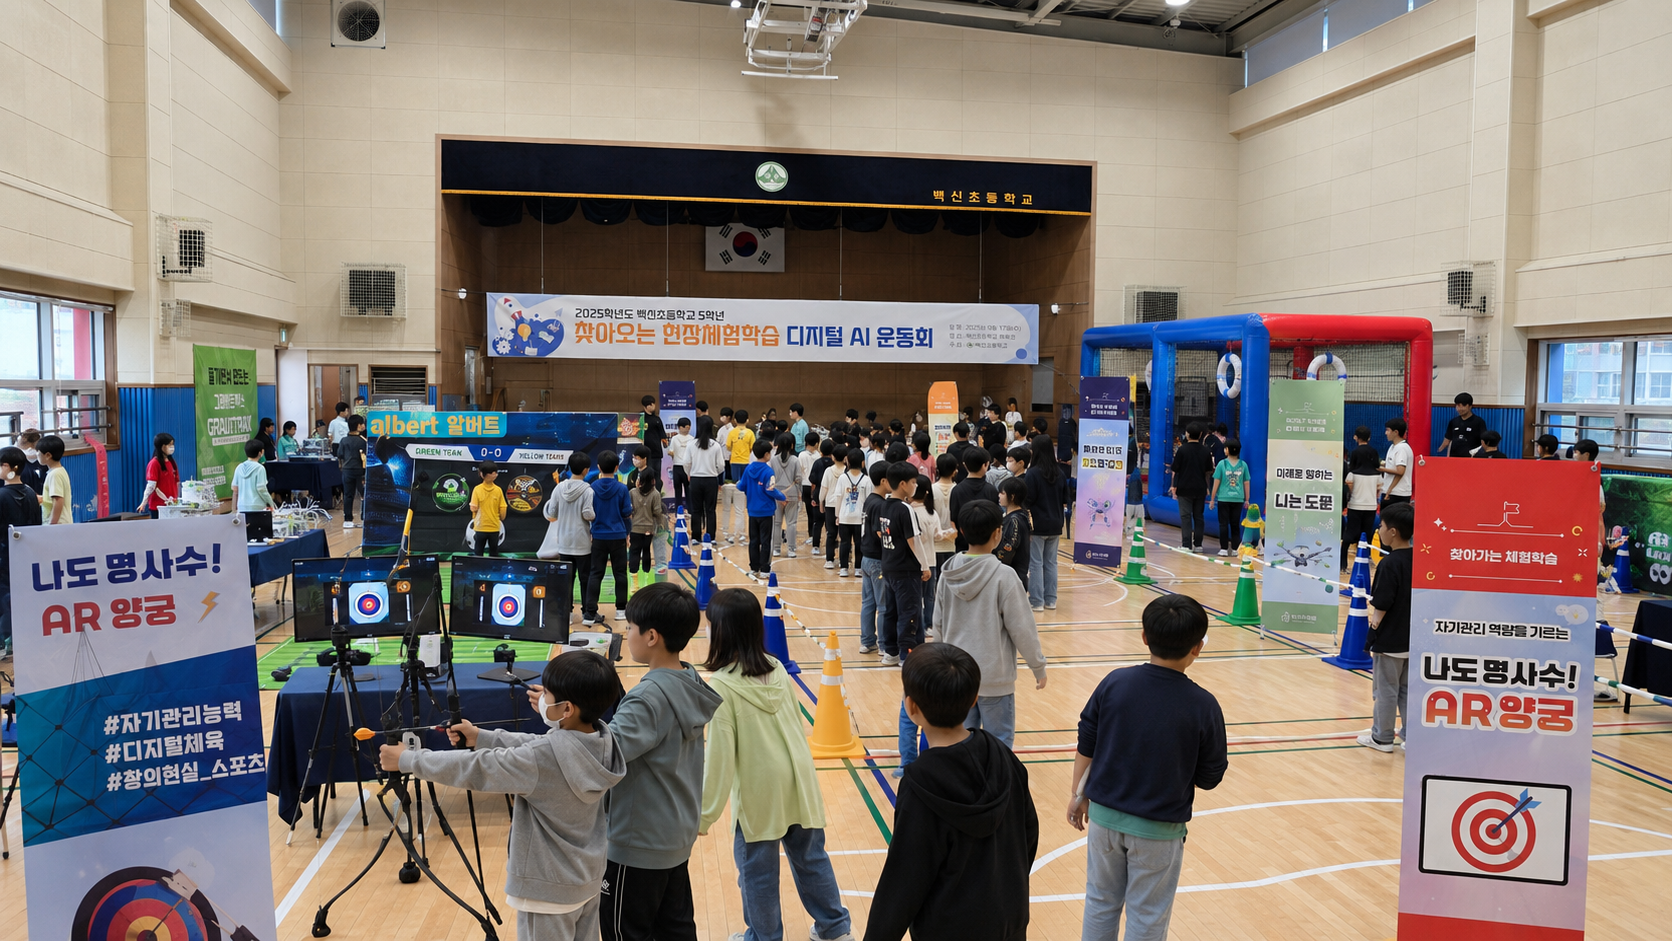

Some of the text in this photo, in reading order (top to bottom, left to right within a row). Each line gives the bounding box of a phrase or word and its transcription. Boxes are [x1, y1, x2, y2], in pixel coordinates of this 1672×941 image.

[932, 189, 1033, 206] 백신초등학교
[575, 308, 725, 321] 2025학년도 백신초등학교 5학년
[574, 320, 934, 349] 찾아오는 현장체험학습 디지털 AI 운동회
[370, 414, 501, 438] albert 알버트
[31, 543, 222, 592] 나도 명사수!
[1449, 548, 1558, 566] 찾아가는 체험학습
[42, 594, 177, 636] AR 양궁
[1435, 620, 1570, 640] 자기관리 역량을 기르는
[1424, 656, 1577, 690] 나도 명사수!
[103, 700, 243, 735] #자기관리능력
[1425, 690, 1575, 733] AR 양궁
[105, 730, 225, 764] #디지털체육
[106, 753, 266, 792] #창의현실_스포츠
